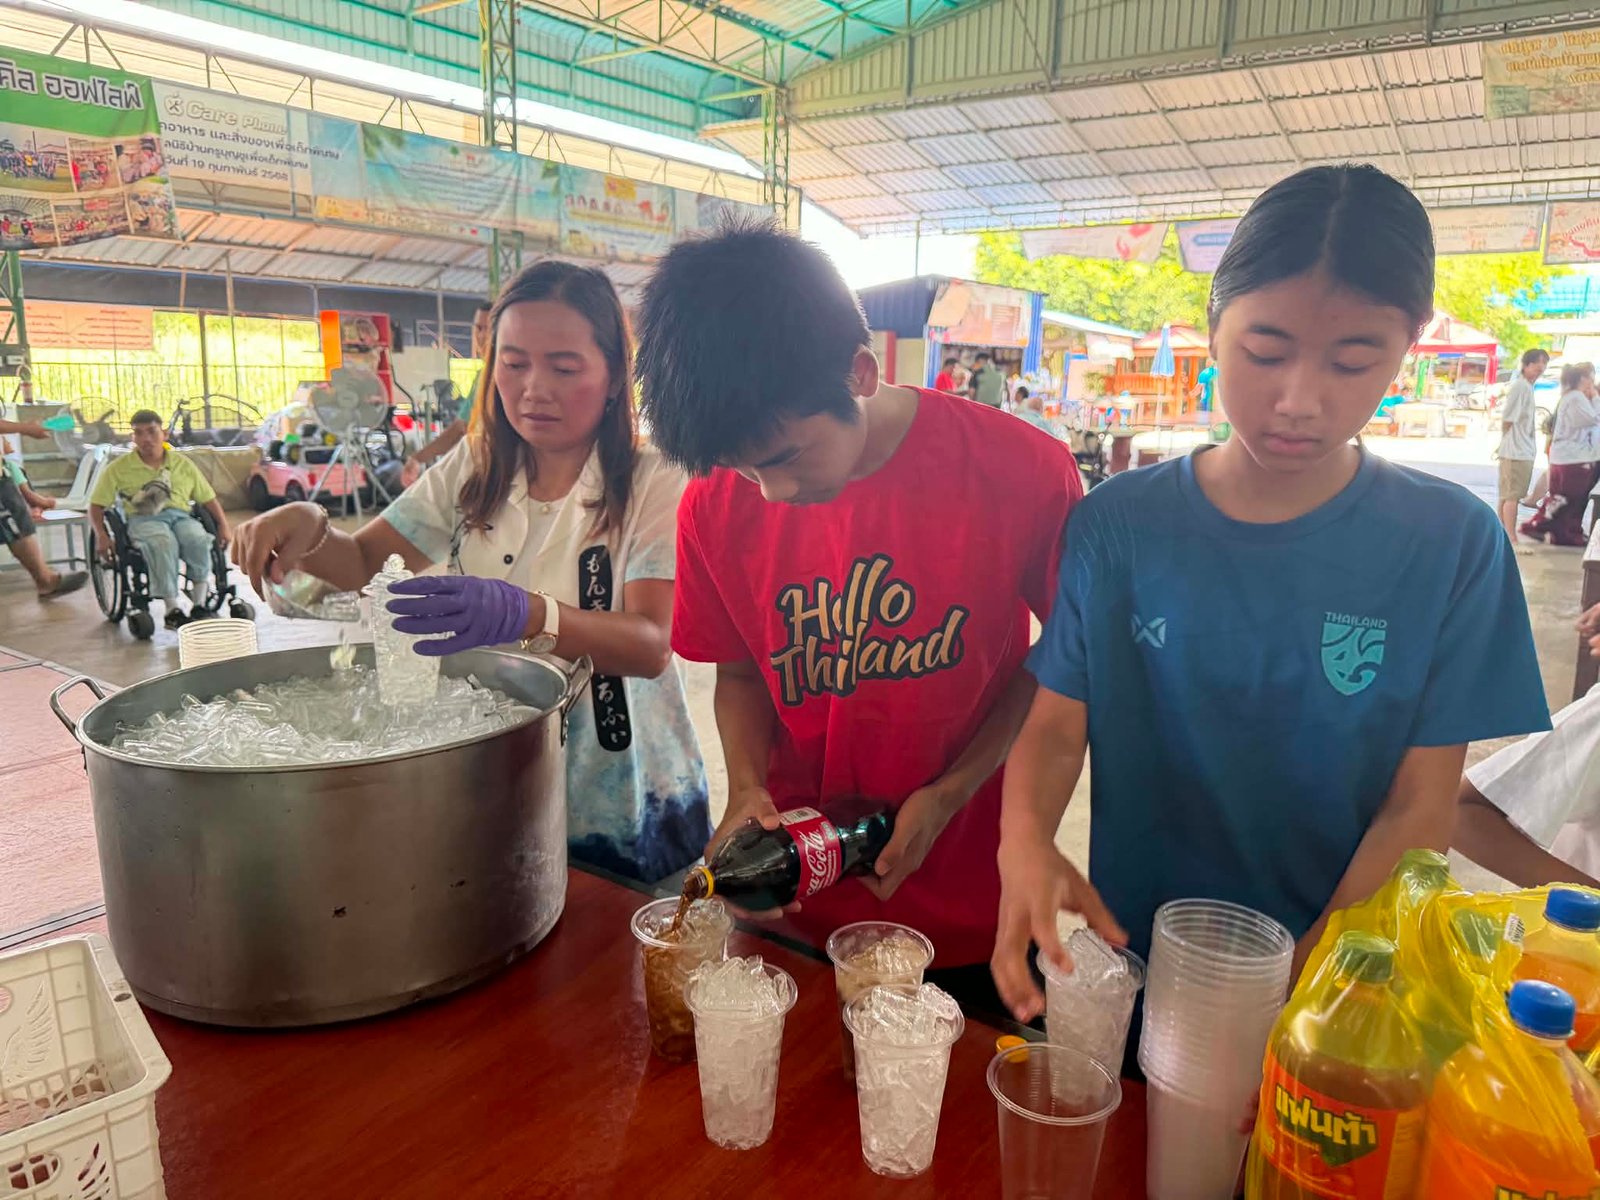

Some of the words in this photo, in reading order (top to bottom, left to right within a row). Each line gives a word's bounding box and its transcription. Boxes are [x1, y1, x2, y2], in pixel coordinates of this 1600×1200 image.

[186, 100, 238, 125] Care
[1324, 611, 1388, 629] THAILAND
[796, 828, 828, 897] ca-Cola
[1275, 1084, 1377, 1146] แฟนต้า
